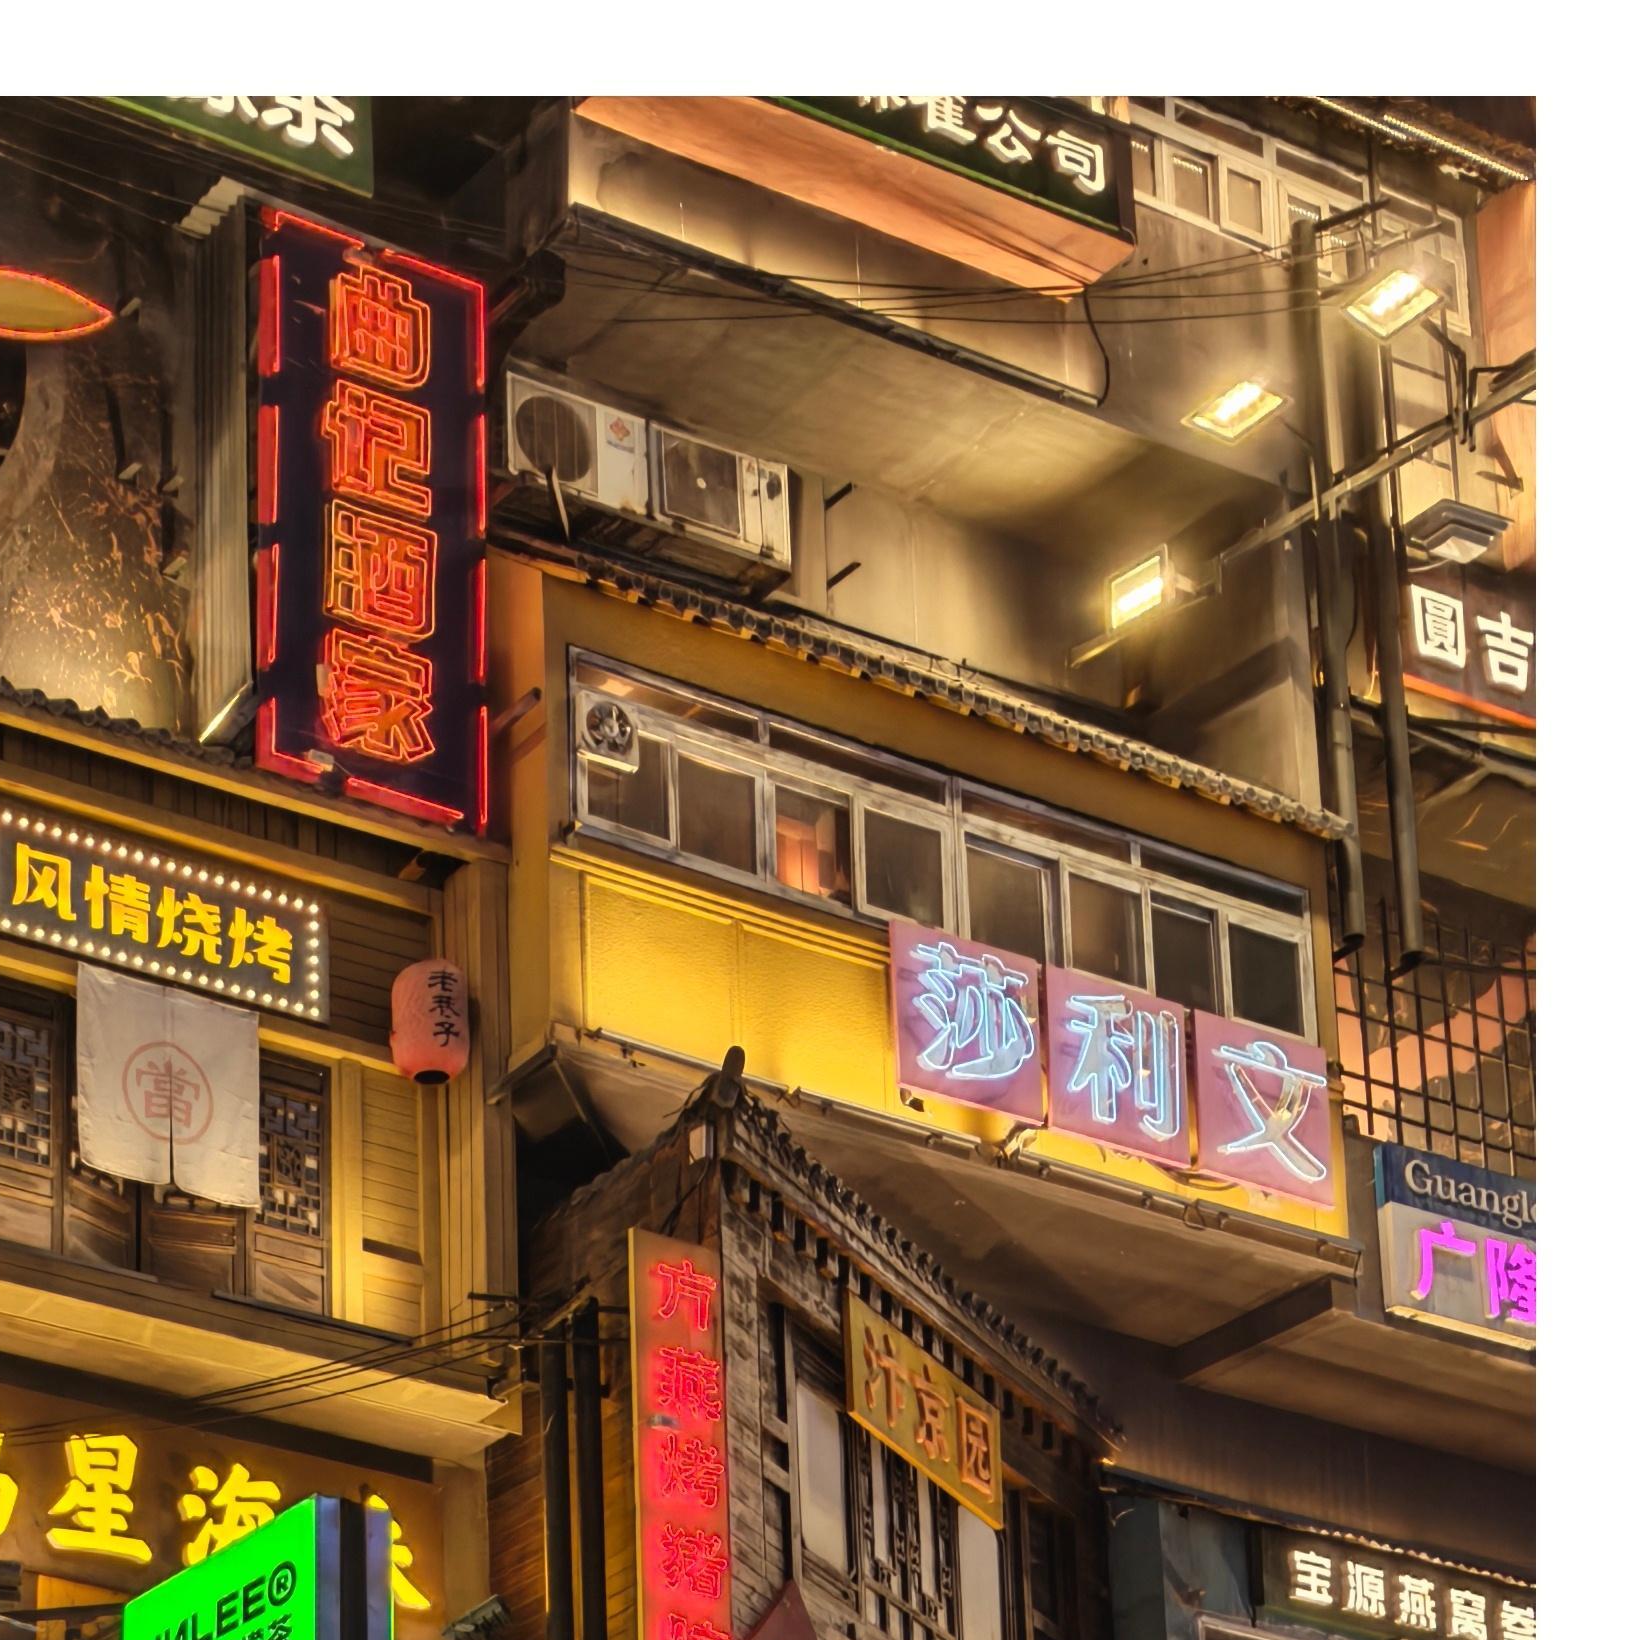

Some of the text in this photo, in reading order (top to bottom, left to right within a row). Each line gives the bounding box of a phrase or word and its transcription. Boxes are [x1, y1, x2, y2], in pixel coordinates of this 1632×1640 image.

[321, 263, 437, 763] 曲记酒家
[12, 841, 294, 984] 风情烧烤
[910, 941, 1328, 1184] 莎利文
[1404, 1159, 1536, 1230] Guangl
